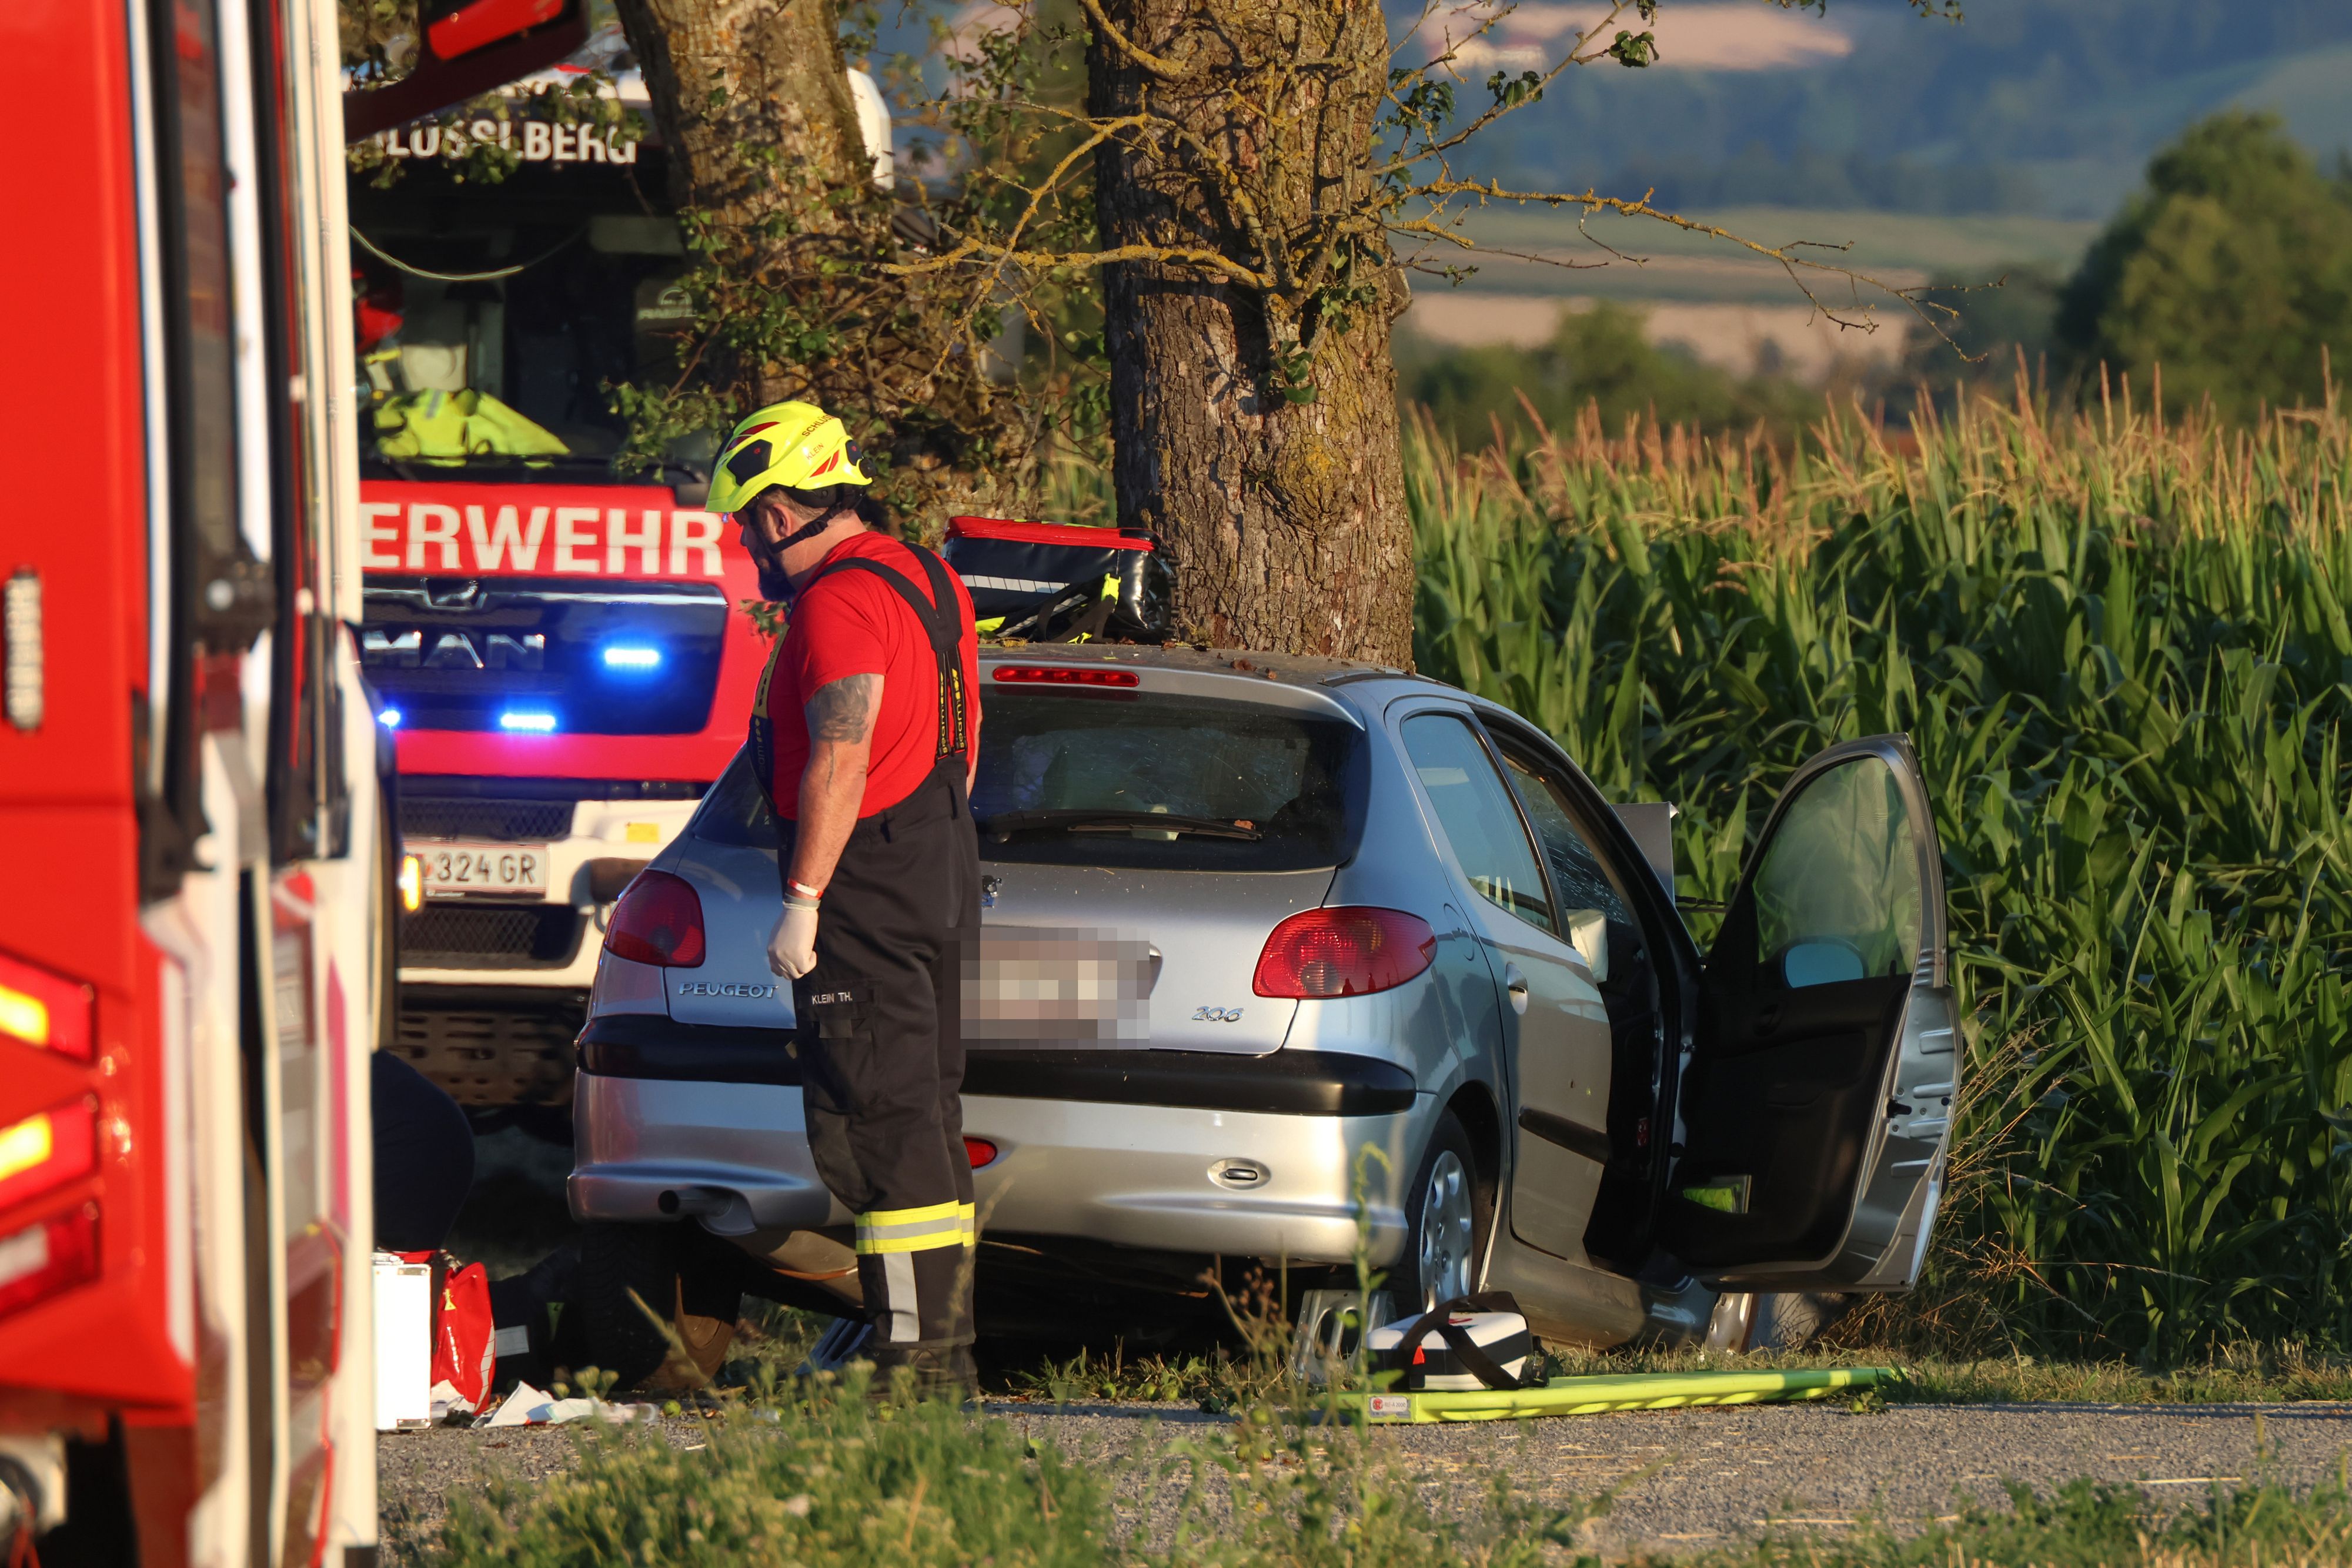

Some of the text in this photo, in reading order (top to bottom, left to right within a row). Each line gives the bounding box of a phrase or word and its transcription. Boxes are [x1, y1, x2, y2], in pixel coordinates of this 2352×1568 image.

[806, 443, 824, 460] KLEIN
[362, 630, 544, 668] MAN
[437, 852, 536, 884] 324 GR
[679, 981, 780, 998] PEUGEOT
[811, 991, 853, 1005] KLEIN TH.
[1191, 1006, 1245, 1022] 206
